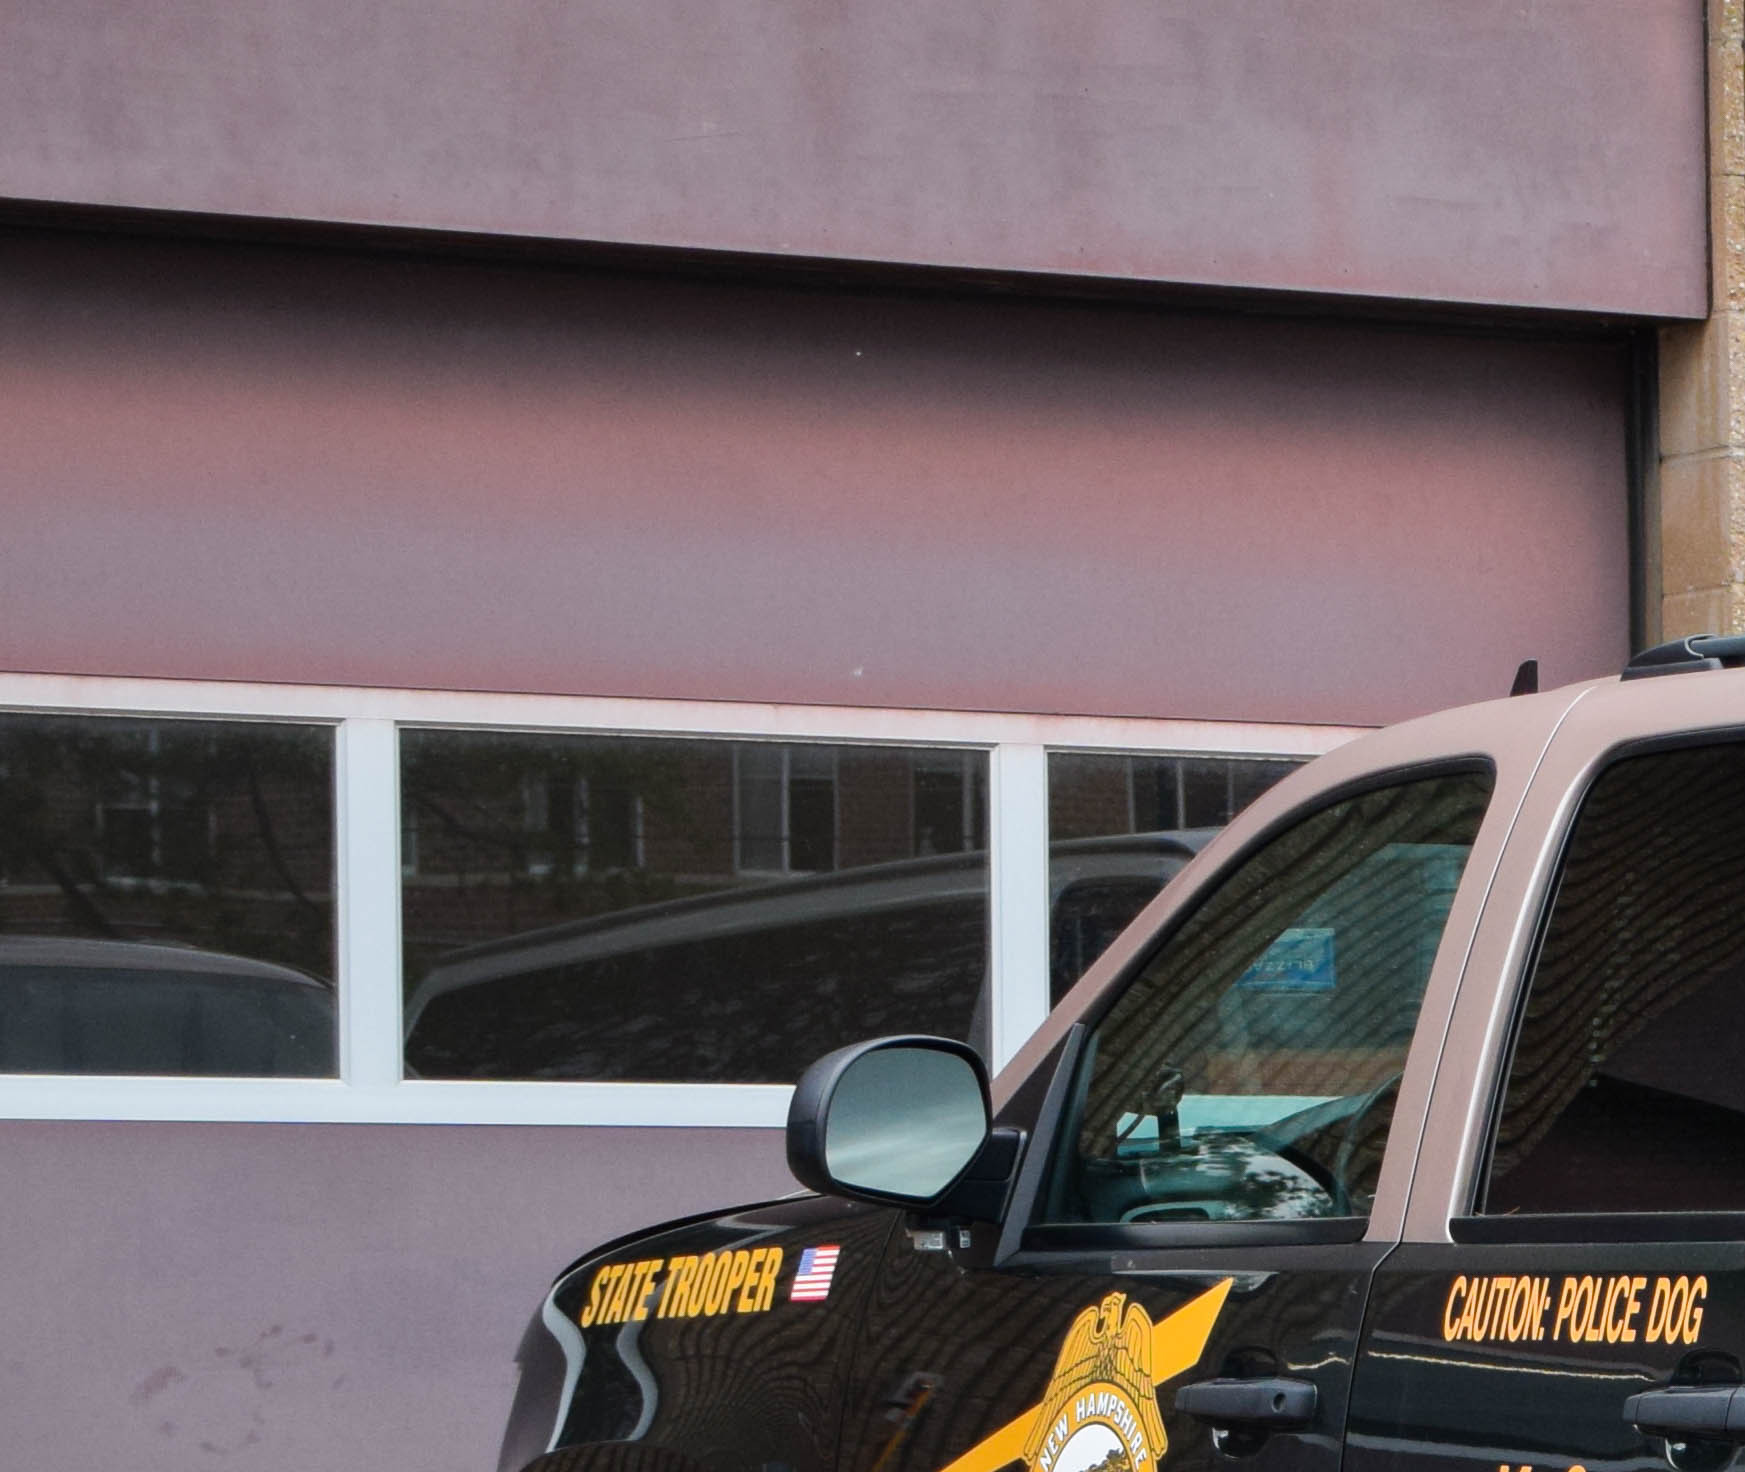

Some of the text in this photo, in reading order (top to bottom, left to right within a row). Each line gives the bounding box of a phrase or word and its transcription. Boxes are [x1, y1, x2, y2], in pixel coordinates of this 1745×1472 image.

[580, 1247, 784, 1328] STATE TROOPER
[1443, 1275, 1708, 1345] CAUTION: POLICE DOG
[1039, 1394, 1147, 1472] NEW HAMPSHIRE
